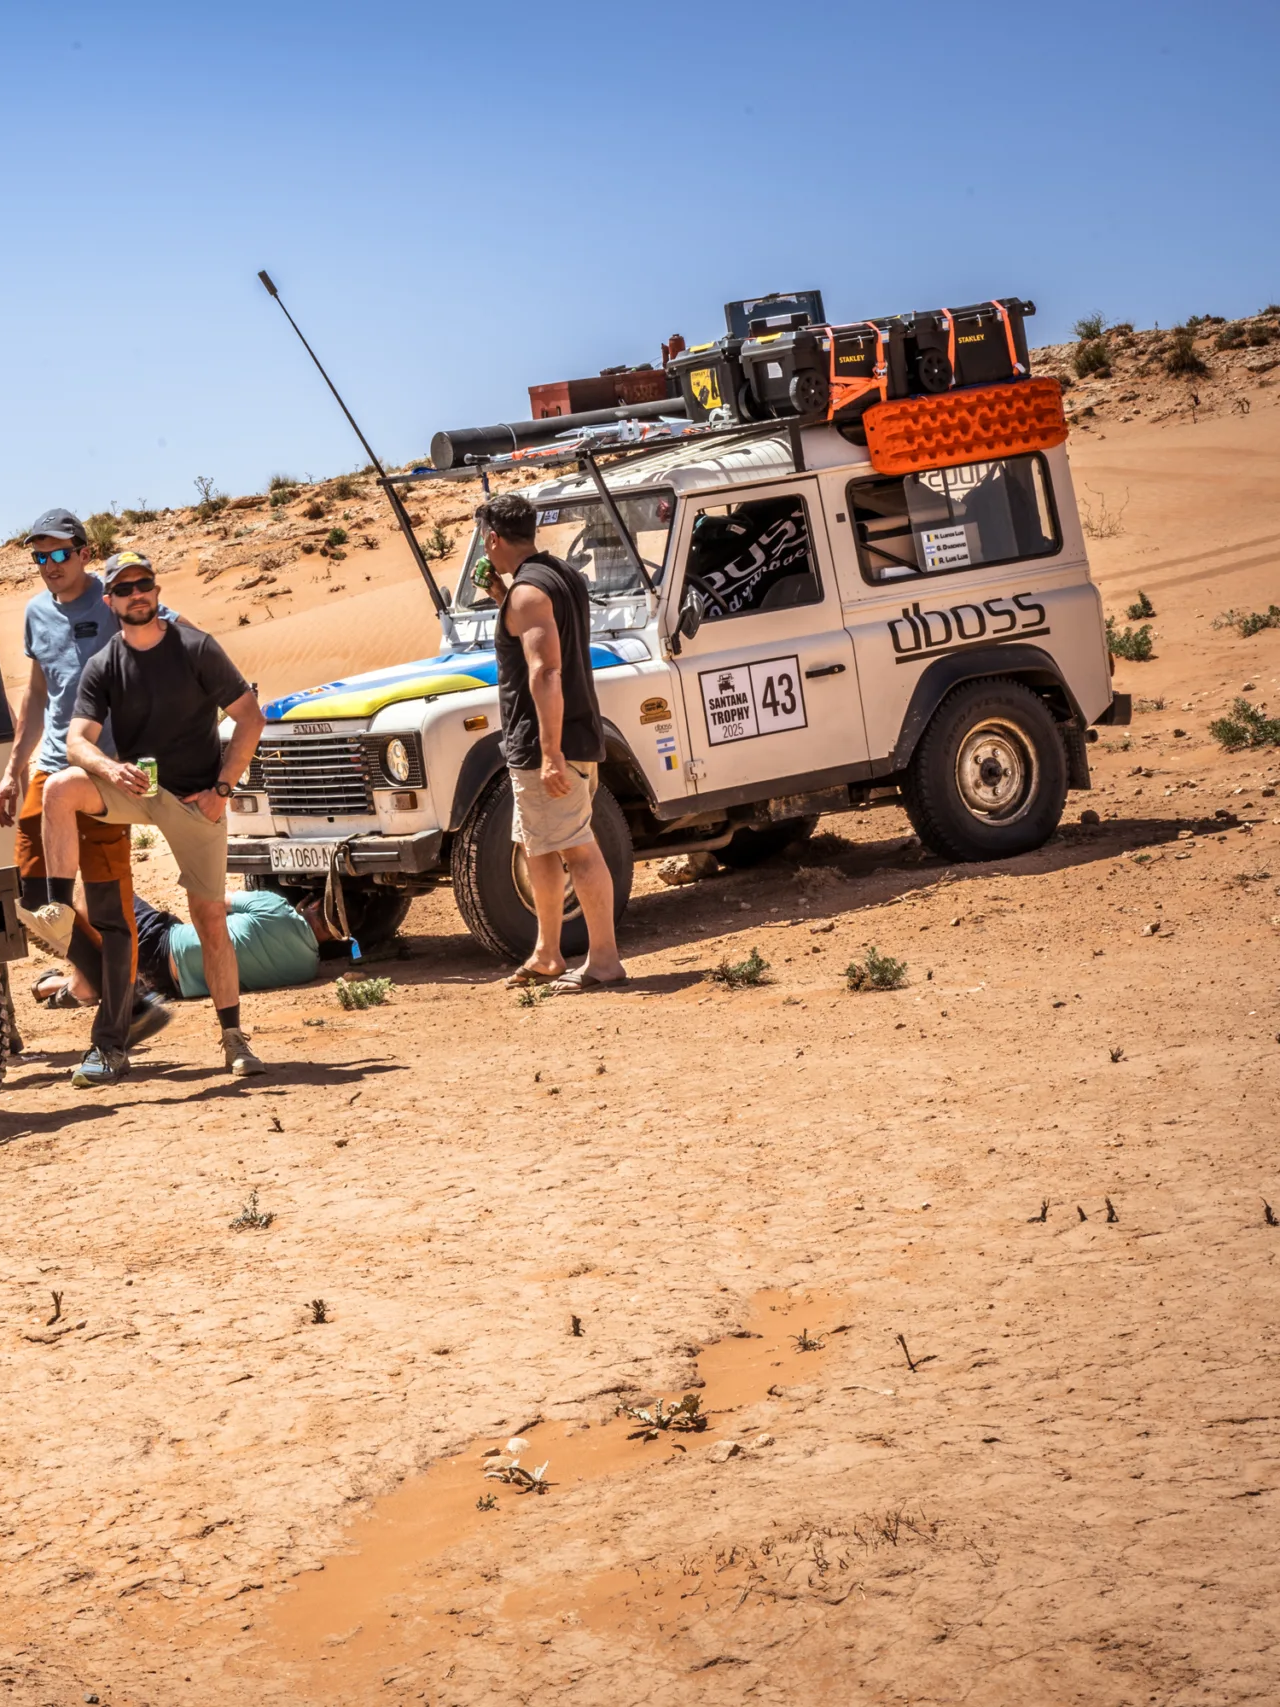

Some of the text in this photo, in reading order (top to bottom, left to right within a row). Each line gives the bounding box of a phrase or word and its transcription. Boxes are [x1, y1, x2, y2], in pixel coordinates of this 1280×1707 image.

[957, 334, 985, 344] STANLEY
[838, 354, 865, 364] STANLEY
[887, 592, 1046, 654] dboss
[709, 692, 749, 711] SANTANA
[761, 673, 797, 717] 43
[710, 706, 750, 726] TROPHY
[292, 723, 333, 735] SANTANA
[722, 723, 744, 739] 2025
